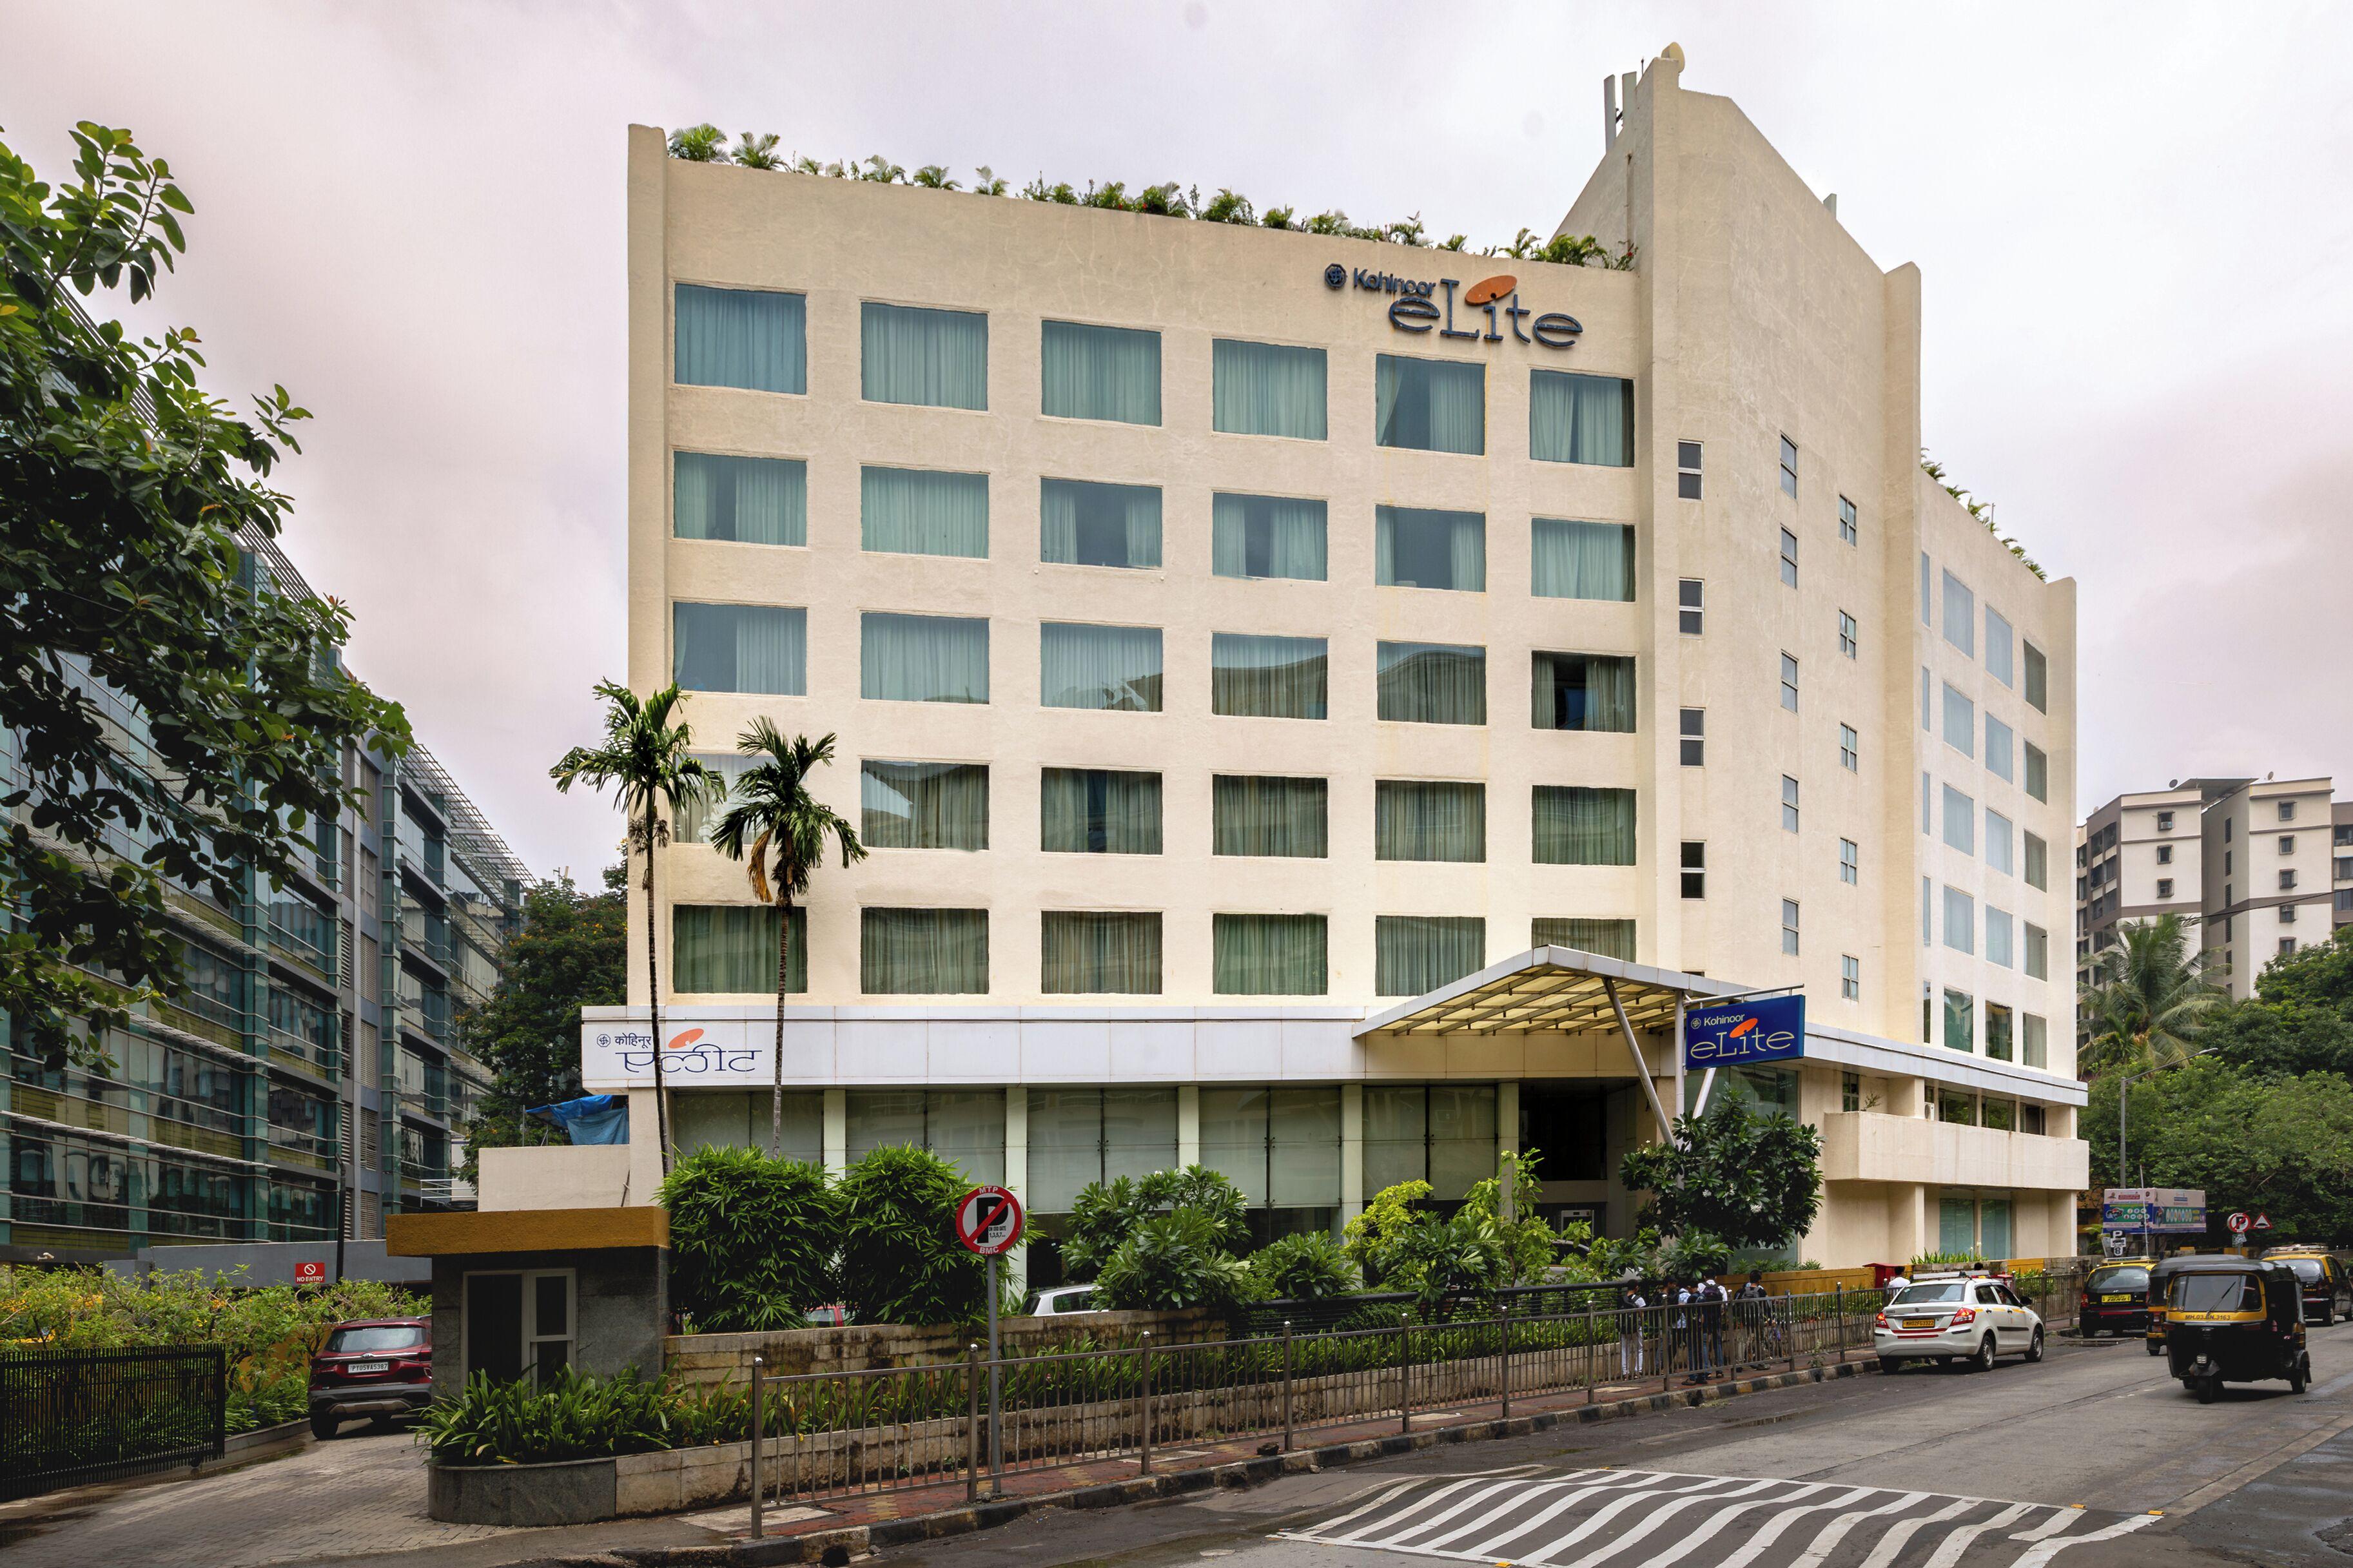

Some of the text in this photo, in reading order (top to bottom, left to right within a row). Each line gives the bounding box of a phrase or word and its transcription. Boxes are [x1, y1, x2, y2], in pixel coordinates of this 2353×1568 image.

[1354, 267, 1437, 298] Kohinoor
[1704, 1014, 1745, 1026] Kohinoor
[614, 1033, 652, 1049] कोहिनूर
[615, 1043, 763, 1073] एलीट
[979, 1186, 999, 1194] MTP
[979, 1246, 999, 1255] BMC
